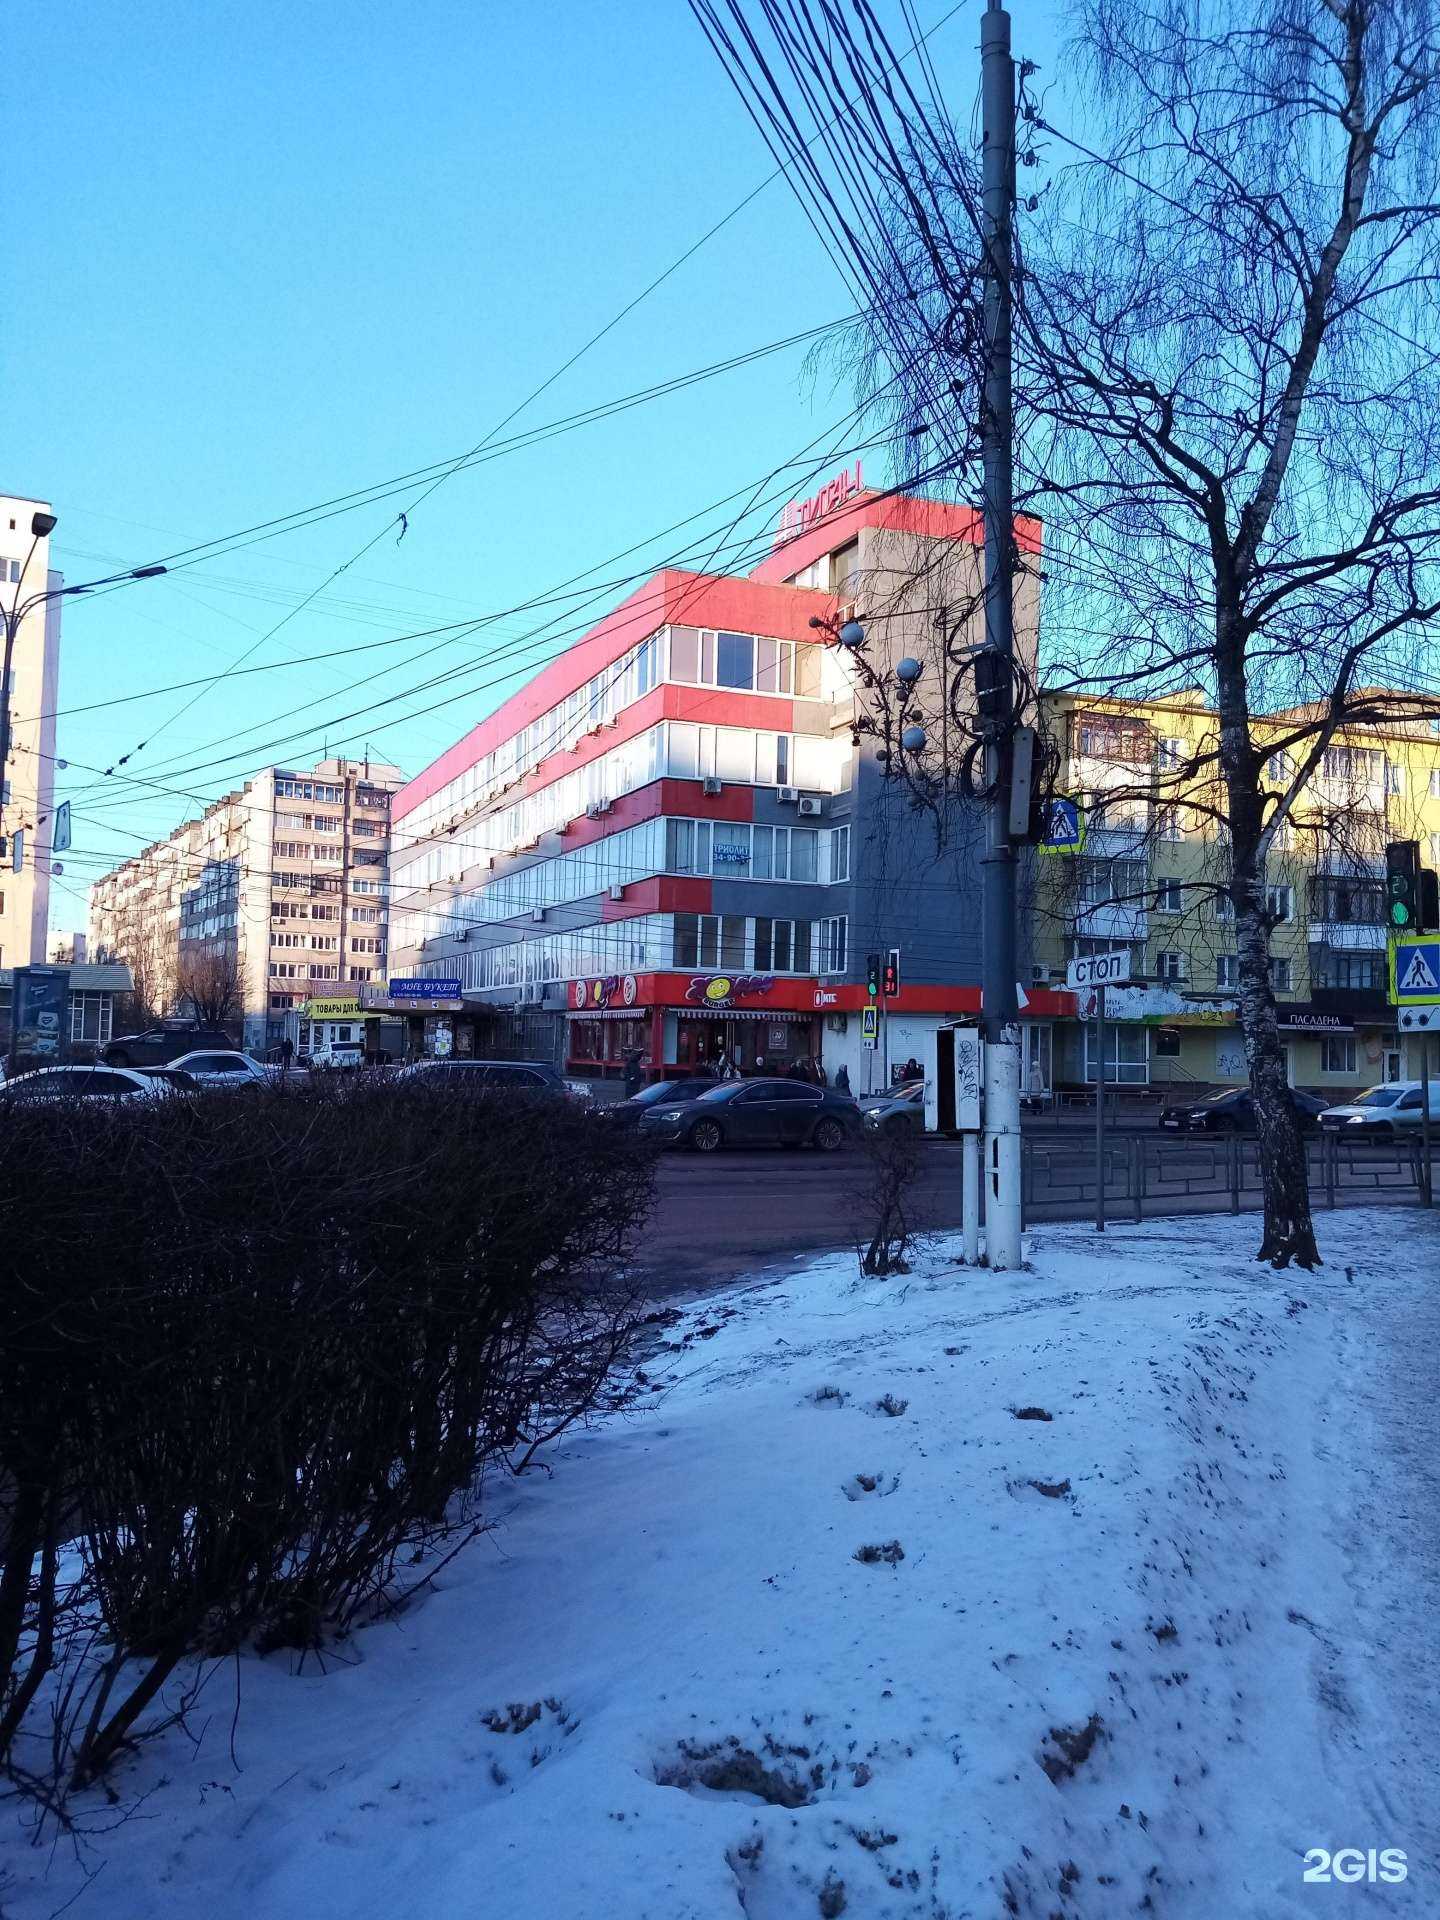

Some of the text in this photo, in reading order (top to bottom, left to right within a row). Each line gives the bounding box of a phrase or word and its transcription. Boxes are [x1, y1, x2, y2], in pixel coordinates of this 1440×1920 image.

[1075, 956, 1121, 982] СТОП
[423, 982, 459, 992] БУКЕТ
[703, 997, 736, 1008] BURGER
[316, 1004, 342, 1014] ТОВАРЫ
[343, 1003, 353, 1015] ДЛЯ
[1290, 1014, 1341, 1026] ПАСАДЕНА
